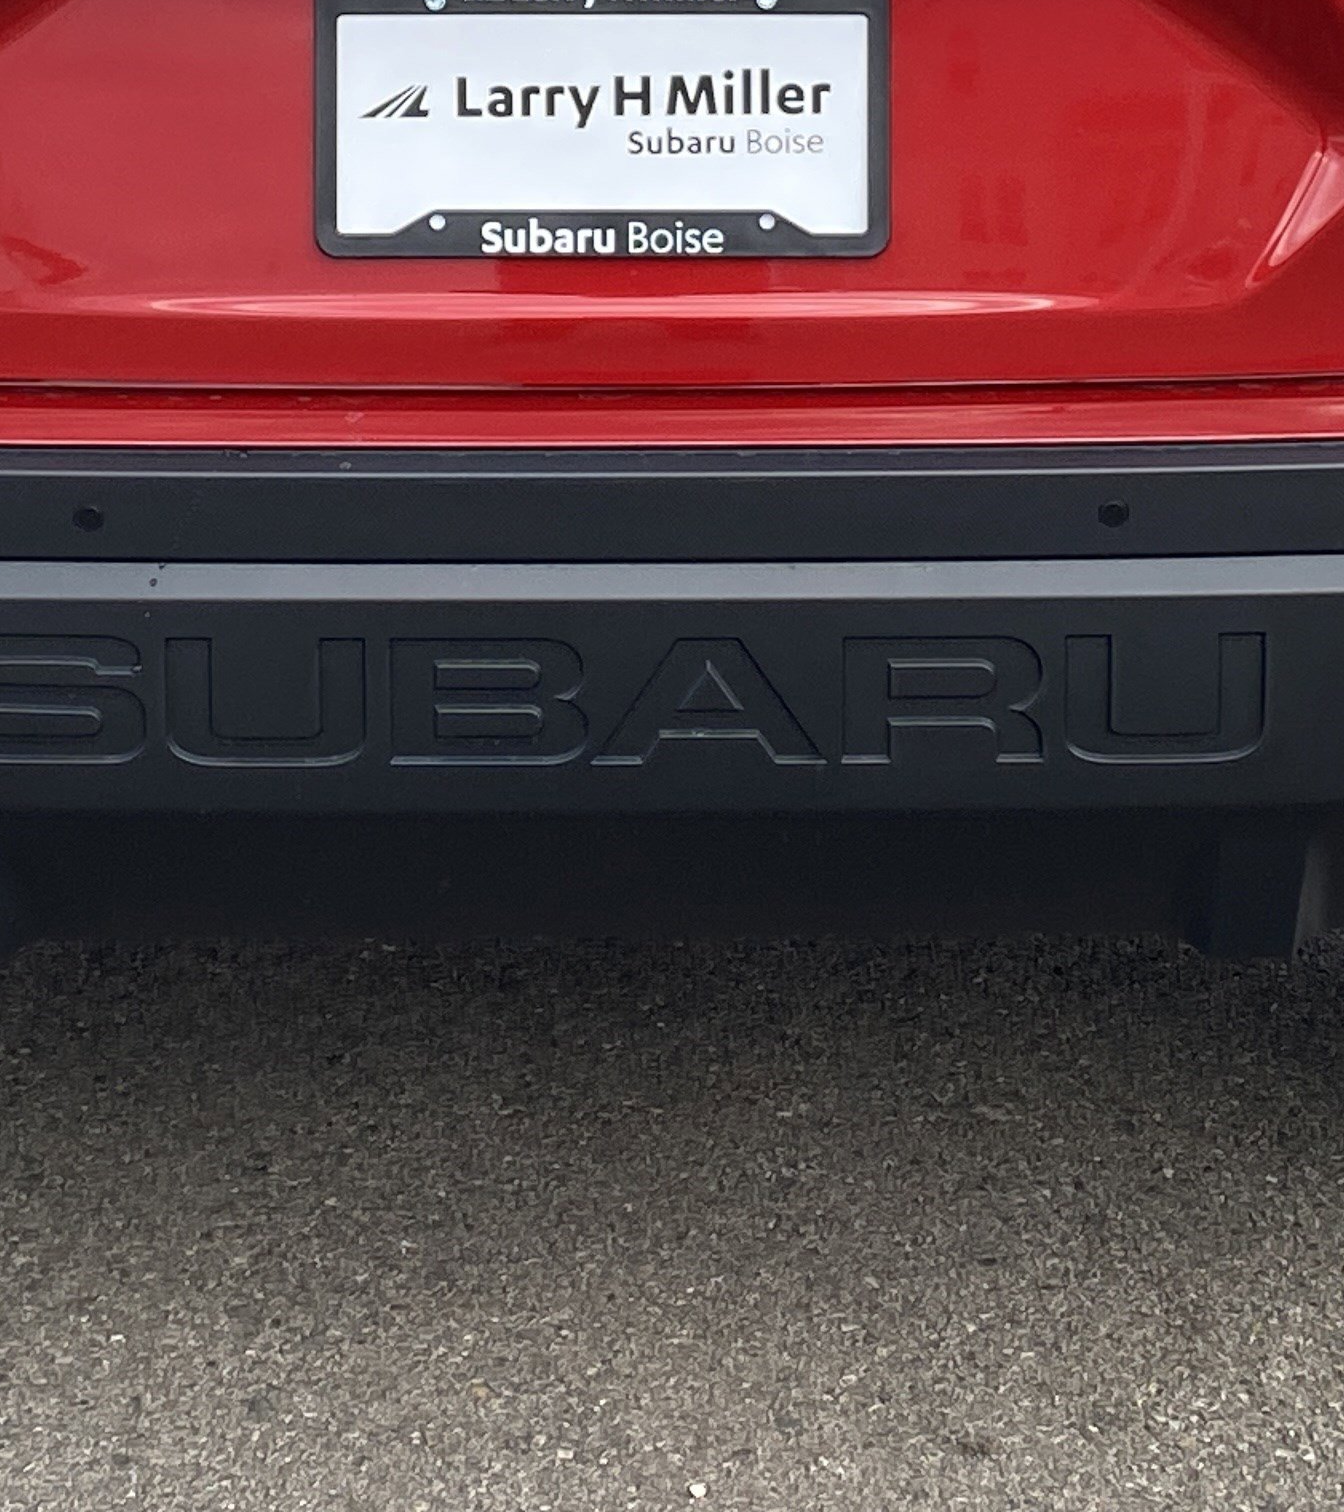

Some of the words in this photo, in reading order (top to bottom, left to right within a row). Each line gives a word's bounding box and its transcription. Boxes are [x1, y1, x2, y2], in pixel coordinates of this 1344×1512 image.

[456, 76, 600, 129] Larry
[614, 76, 651, 116] H
[667, 68, 831, 115] Miller
[627, 126, 735, 155] Subaru
[746, 128, 824, 154] Boise
[481, 217, 616, 254] Subaru
[627, 218, 725, 254] Boise
